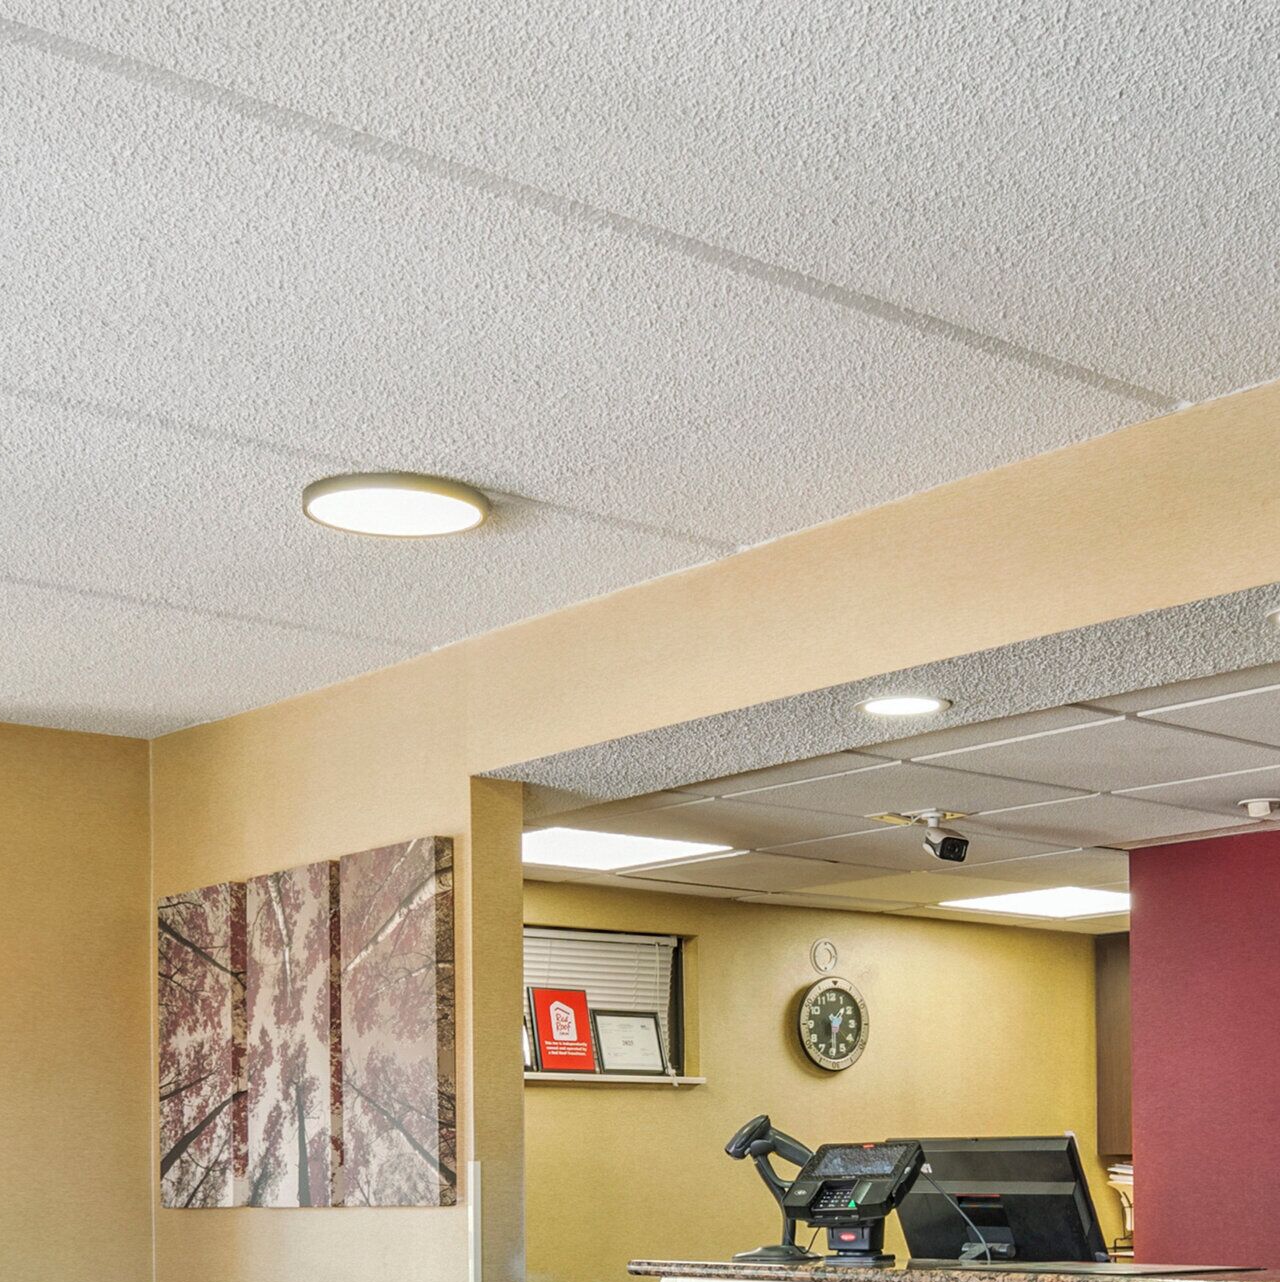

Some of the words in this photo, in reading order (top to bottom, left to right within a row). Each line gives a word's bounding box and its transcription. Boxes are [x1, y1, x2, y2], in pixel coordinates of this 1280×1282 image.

[817, 996, 826, 1005] 11
[826, 993, 836, 1002] 12
[811, 1006, 820, 1015] 10
[845, 1006, 853, 1015] 2
[808, 1020, 815, 1029] 9
[848, 1019, 856, 1028] 3
[811, 1034, 818, 1043] 8
[818, 1043, 826, 1053] 7
